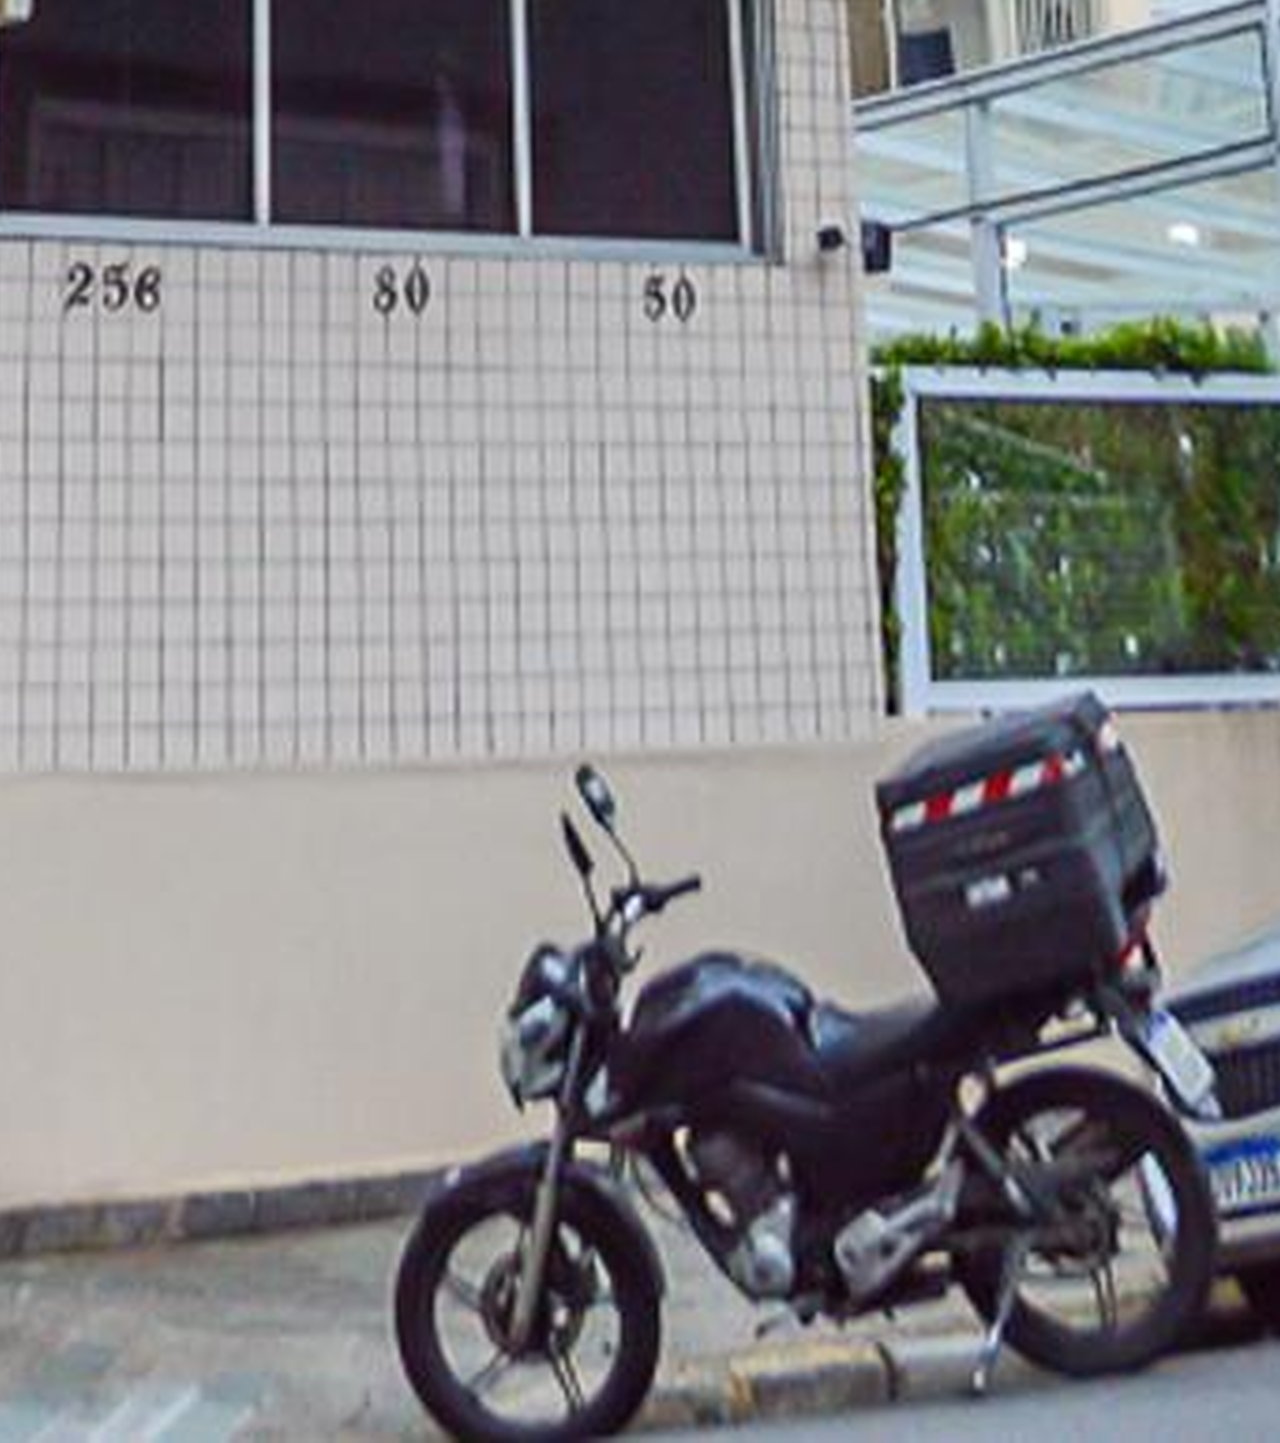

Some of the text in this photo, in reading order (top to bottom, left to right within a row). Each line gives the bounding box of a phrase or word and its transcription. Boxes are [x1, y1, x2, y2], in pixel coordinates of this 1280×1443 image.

[62, 261, 696, 323] 256 80 50
